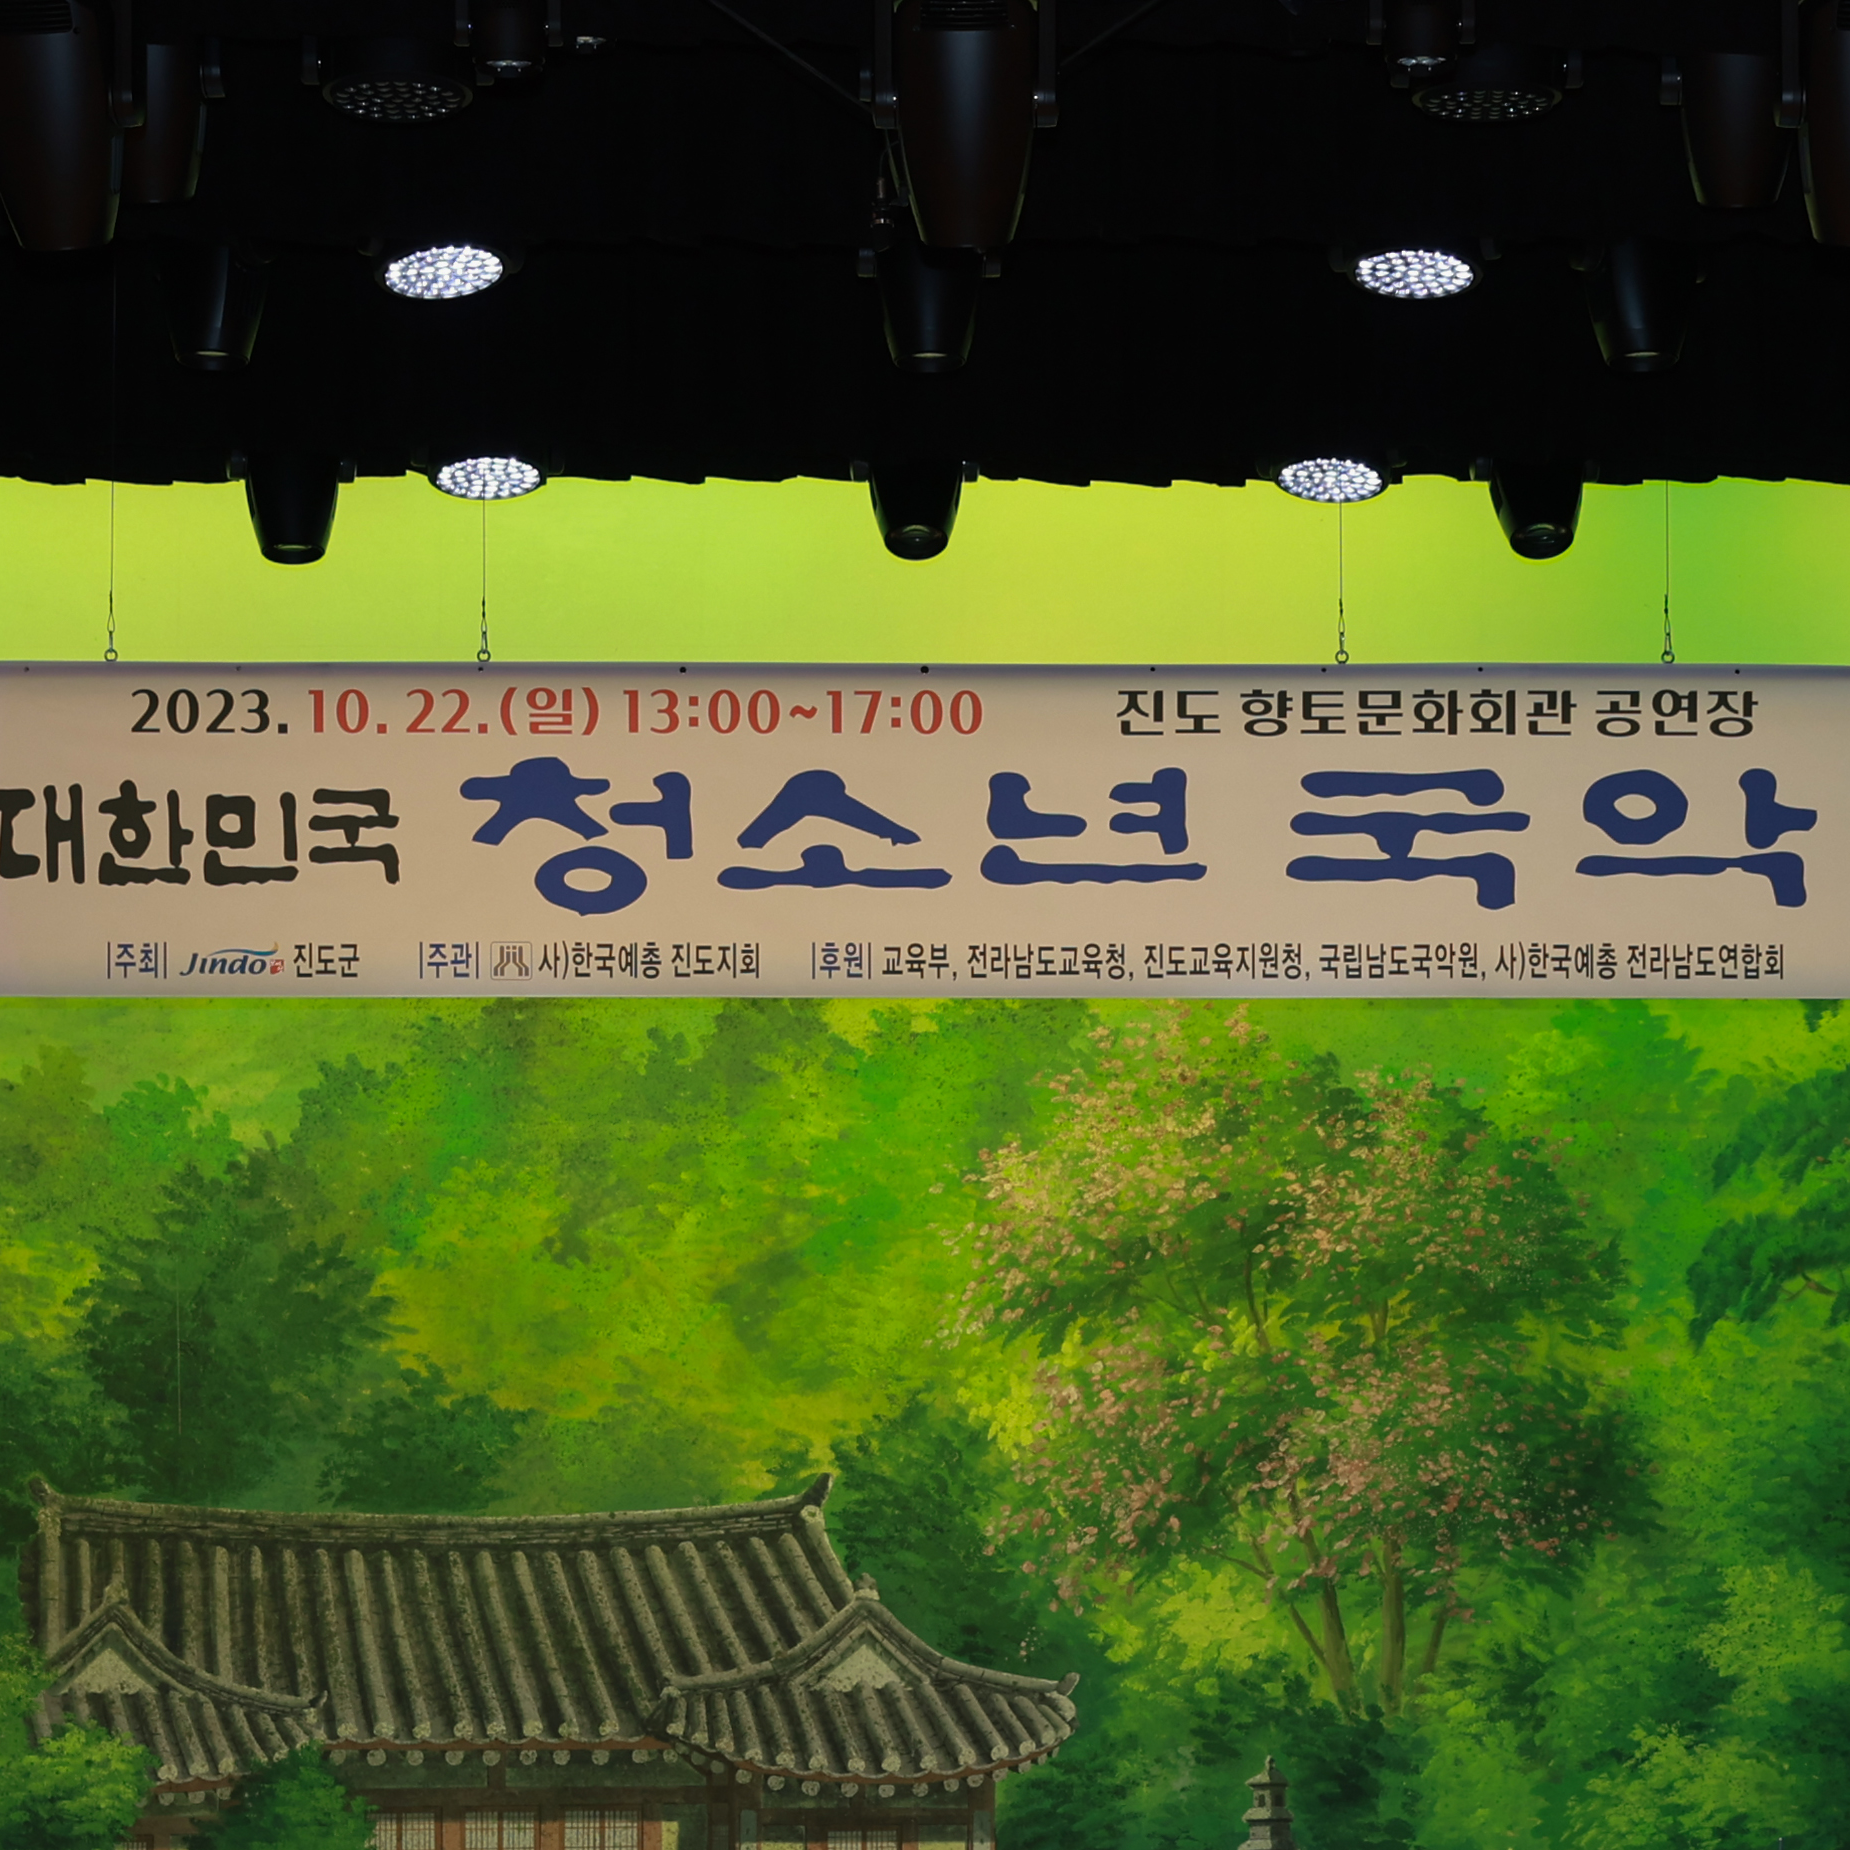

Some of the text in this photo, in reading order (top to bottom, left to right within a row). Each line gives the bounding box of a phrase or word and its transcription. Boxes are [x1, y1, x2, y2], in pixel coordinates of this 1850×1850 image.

[131, 688, 288, 734] 2023.
[308, 688, 387, 734] 10.
[622, 688, 983, 735] 13:00~17:00
[1116, 690, 1221, 736] 진도
[1239, 688, 1578, 737] 향토문화회관
[1595, 688, 1759, 738] 공연장
[460, 757, 1207, 916] 청소년
[293, 943, 360, 978] 진도군
[538, 941, 662, 979] 사)한국예총
[670, 943, 760, 979] 진도지회
[881, 943, 958, 981] 교육부,
[967, 943, 1134, 981] 전라남도교육청,
[1143, 943, 1310, 981] 진도교육지원청,
[1318, 942, 1487, 981] 국립남도국악원,
[1494, 942, 1619, 980] 사)한국예총
[1626, 943, 1785, 980] 전라남도연합회
